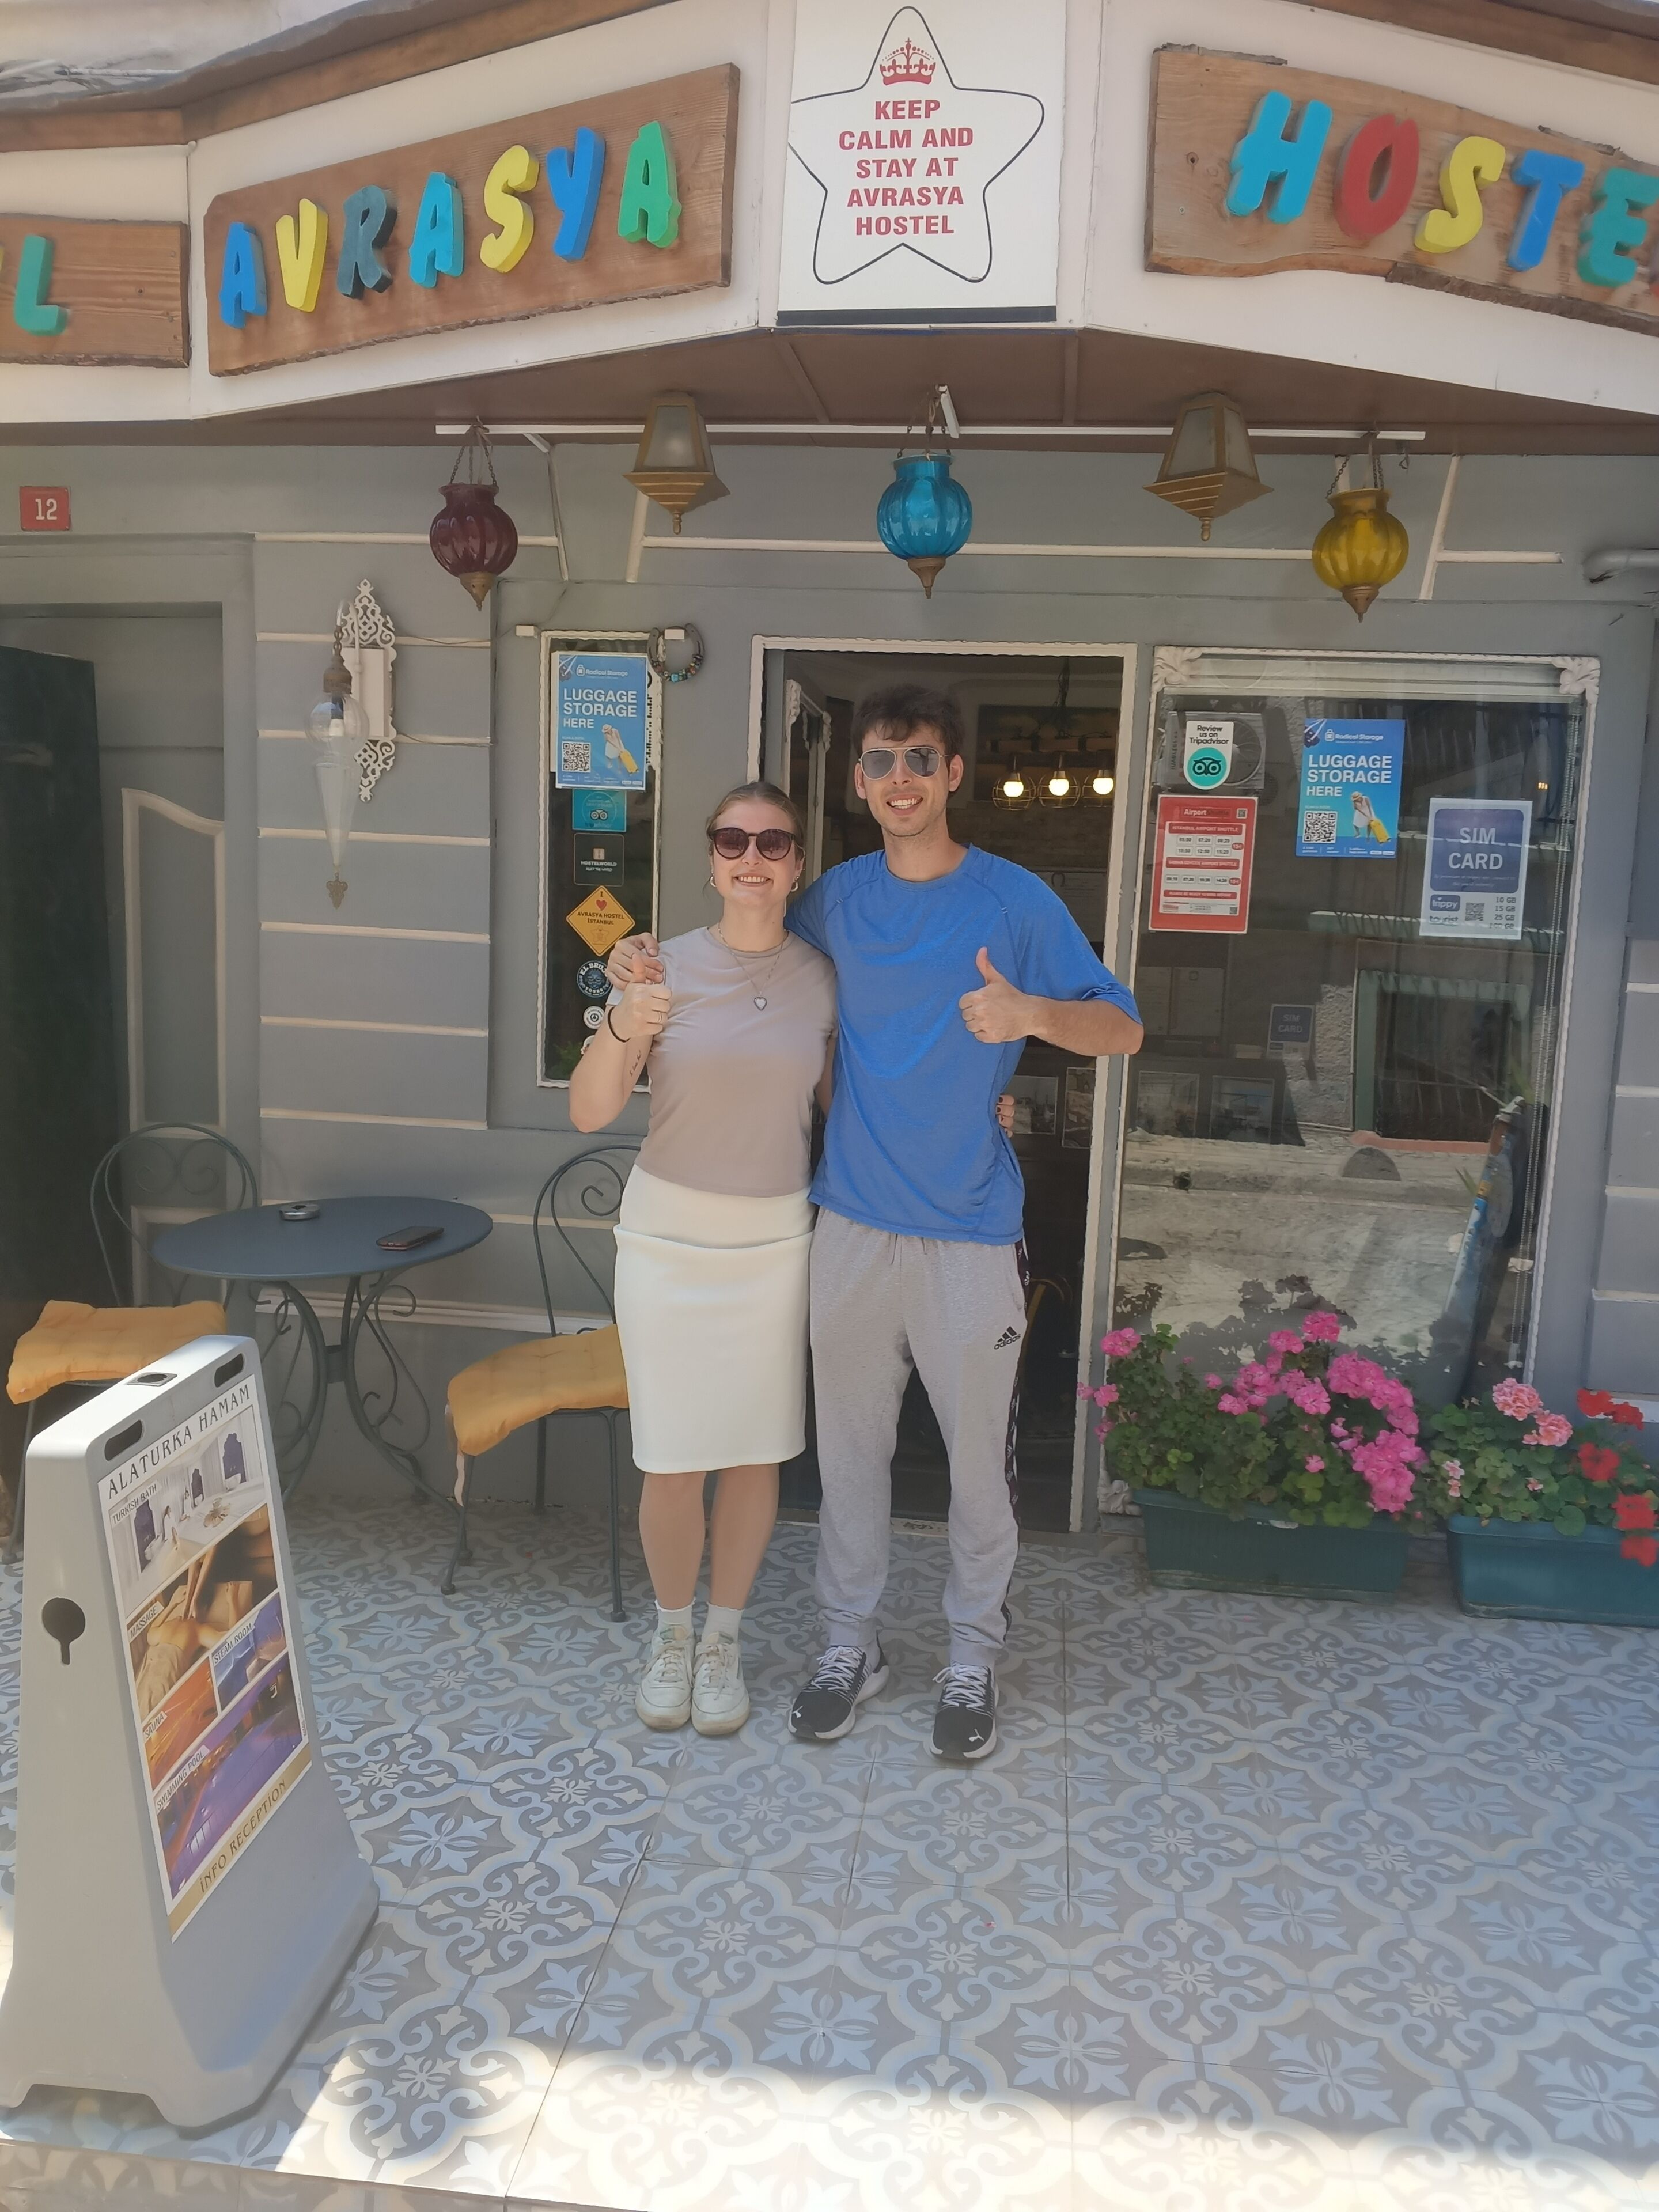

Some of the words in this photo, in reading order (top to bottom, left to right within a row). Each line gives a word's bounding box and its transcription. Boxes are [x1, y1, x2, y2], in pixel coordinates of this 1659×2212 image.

[874, 99, 940, 120] KEEP
[839, 130, 912, 150] CALM
[922, 127, 974, 147] AND
[856, 158, 917, 179] STAY
[926, 157, 959, 176] AT
[847, 186, 964, 207] AVRASYA
[1225, 90, 1659, 297] HOSTE
[218, 120, 682, 329] AVRASYA
[856, 215, 954, 236] HOSTEL
[0, 233, 69, 338] L
[35, 498, 58, 521] 12
[563, 688, 637, 703] LUGGAGE
[563, 703, 637, 717] STORAGE
[563, 718, 594, 728] HERE
[1309, 755, 1392, 768] LUGGAGE
[1307, 770, 1392, 783] STORAGE
[1306, 786, 1343, 797] HERE
[1460, 827, 1496, 844] SIM
[1448, 853, 1503, 870] CARD
[580, 966, 589, 975] EL
[588, 962, 607, 974] BRUJ
[1283, 1014, 1300, 1022] SIM
[994, 1334, 1021, 1350] adidas
[108, 1425, 192, 1500] ALATURKA
[198, 1384, 250, 1433] HAMAM
[112, 1498, 139, 1524] TURKISH
[141, 1483, 157, 1503] BATH
[131, 1605, 157, 1638] MASSAGE
[214, 1641, 233, 1664] STEAM
[234, 1623, 252, 1643] ROOM
[145, 1713, 164, 1738] SAUNA
[157, 1769, 188, 1810] SWIMMING
[188, 1750, 204, 1771] POOL
